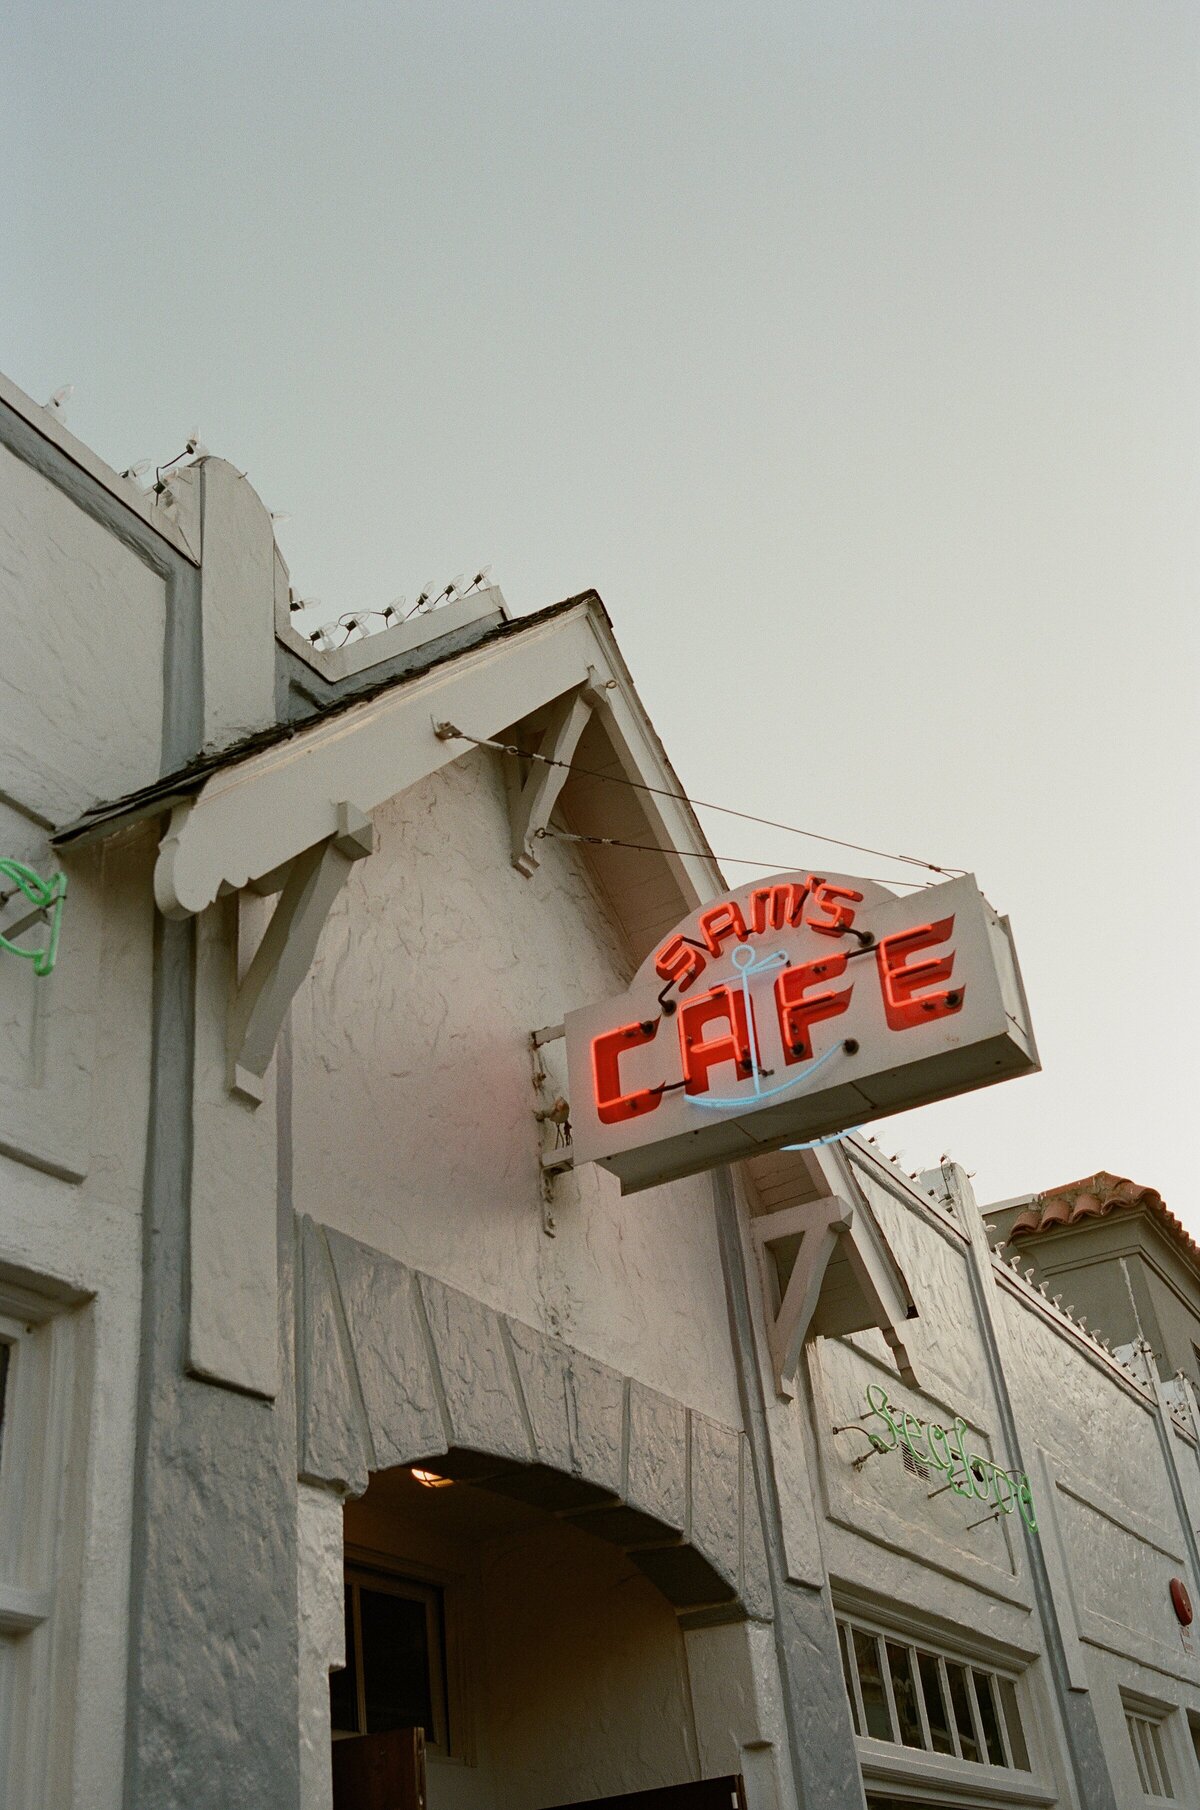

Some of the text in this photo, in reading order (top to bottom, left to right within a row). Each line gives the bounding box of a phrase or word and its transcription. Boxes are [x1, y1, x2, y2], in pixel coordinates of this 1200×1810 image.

[654, 874, 864, 993] SAM'S
[591, 912, 967, 1125] CAFE
[866, 1383, 1038, 1533] Seafood
